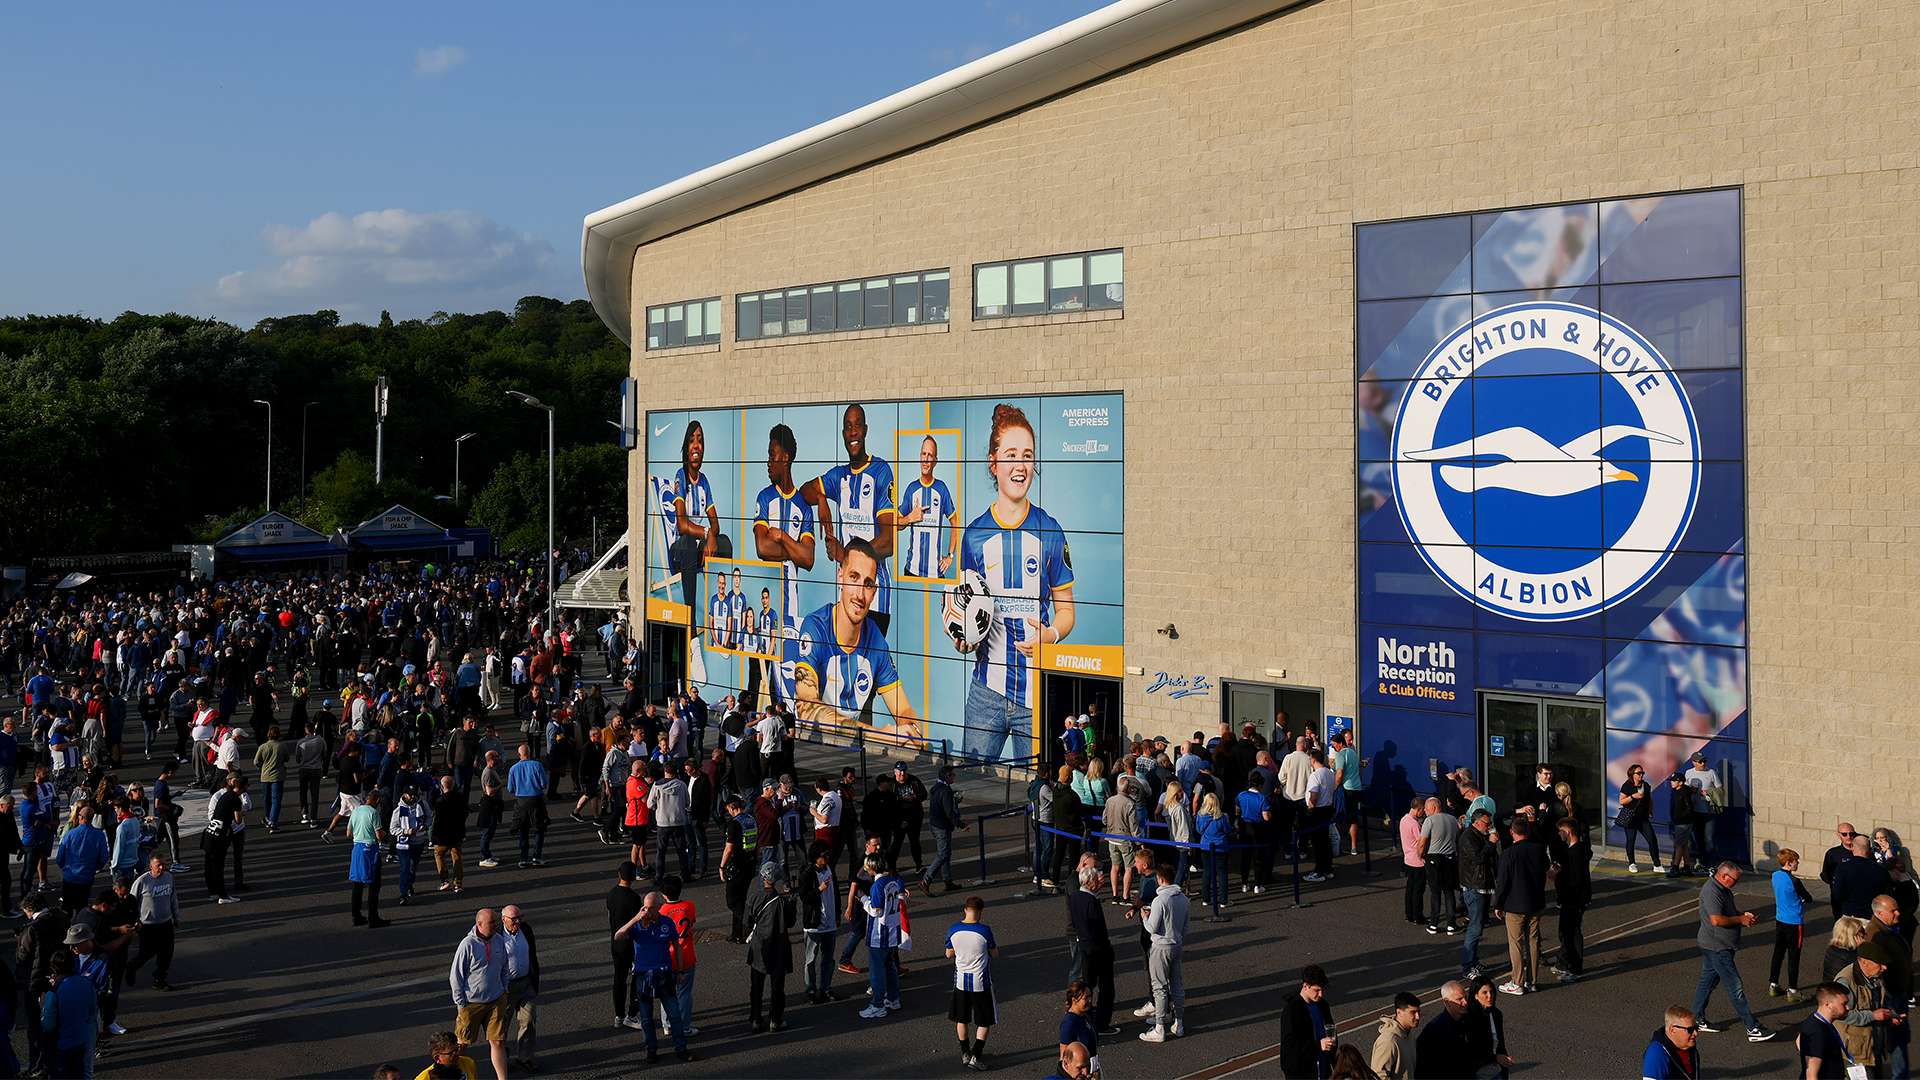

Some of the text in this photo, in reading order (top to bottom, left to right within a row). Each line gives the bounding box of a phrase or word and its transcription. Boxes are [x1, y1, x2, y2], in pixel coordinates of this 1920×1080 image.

[1422, 318, 1660, 402] BRIGHTON & HOVE
[1062, 408, 1108, 417] AMERICAN
[1068, 418, 1109, 426] EXPRESS
[1478, 572, 1594, 605] ALBION
[999, 604, 1035, 613] EXPRESS
[1378, 637, 1455, 668] North
[1055, 654, 1102, 671] ENTRANCE
[1378, 664, 1455, 685] Reception
[1378, 683, 1455, 700] & Club Offices
